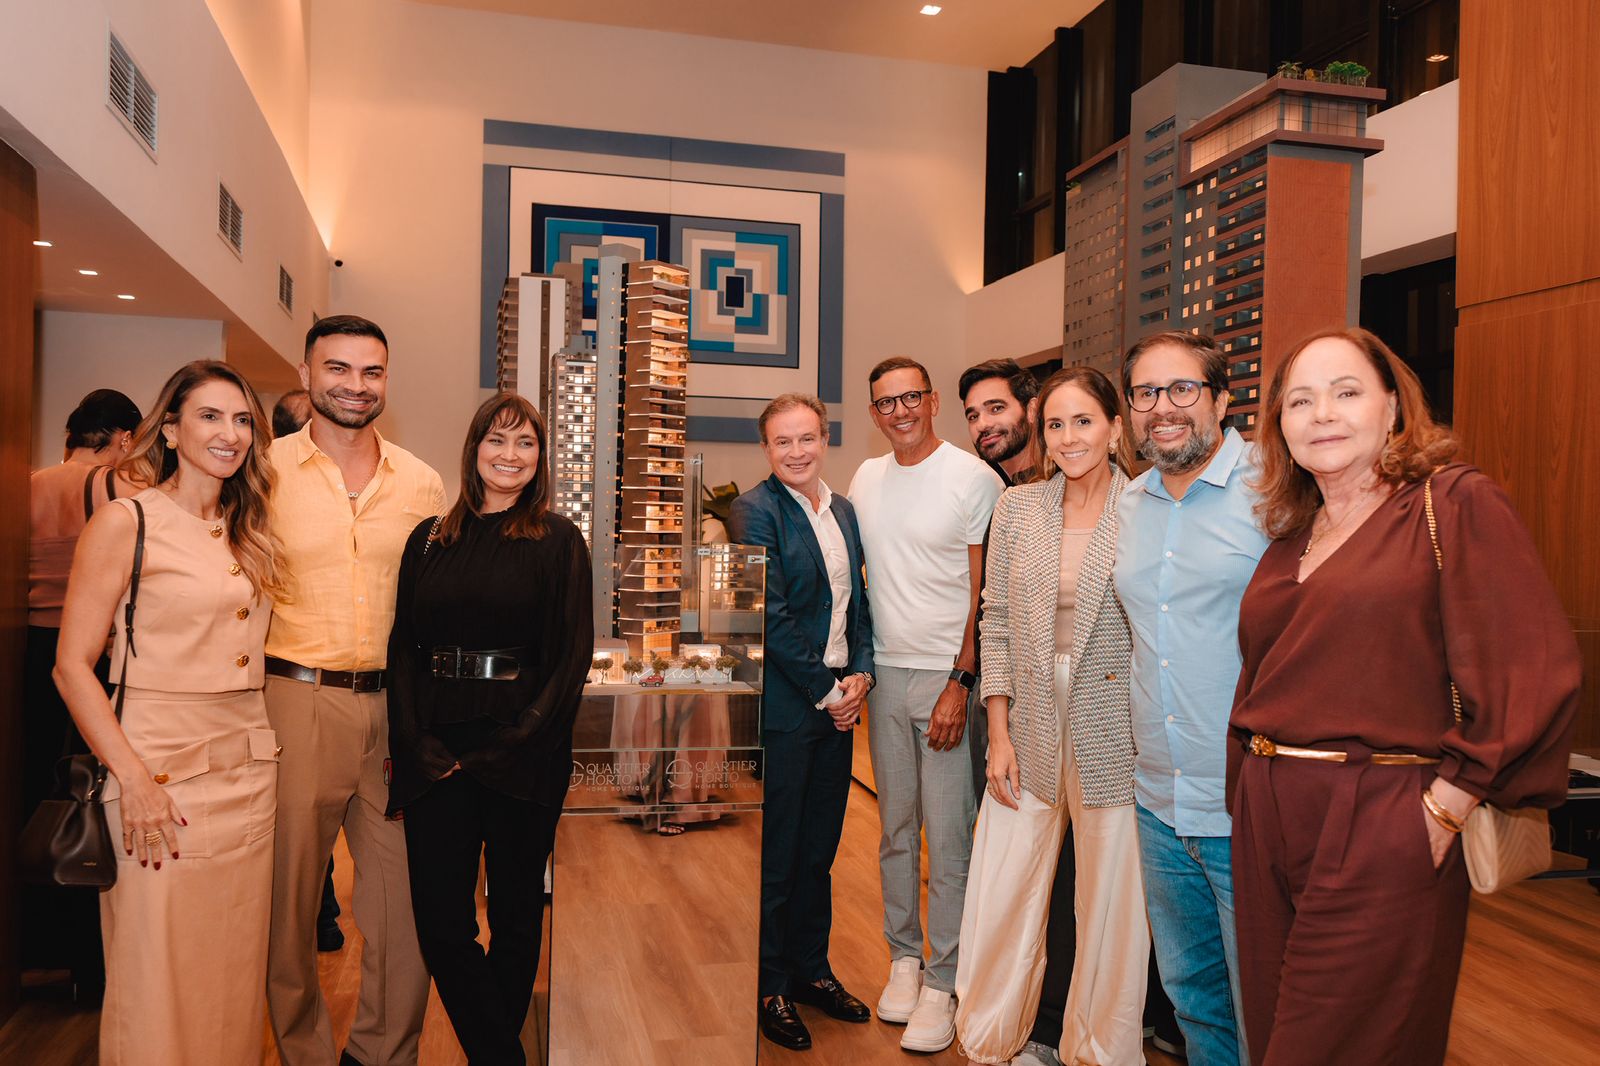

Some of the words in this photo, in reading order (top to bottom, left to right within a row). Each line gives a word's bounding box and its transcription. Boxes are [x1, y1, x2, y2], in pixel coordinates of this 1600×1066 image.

[586, 763, 651, 775] QUARTIER
[695, 760, 757, 772] QUARTIER
[586, 774, 632, 785] HORTO
[695, 771, 739, 783] HORTO
